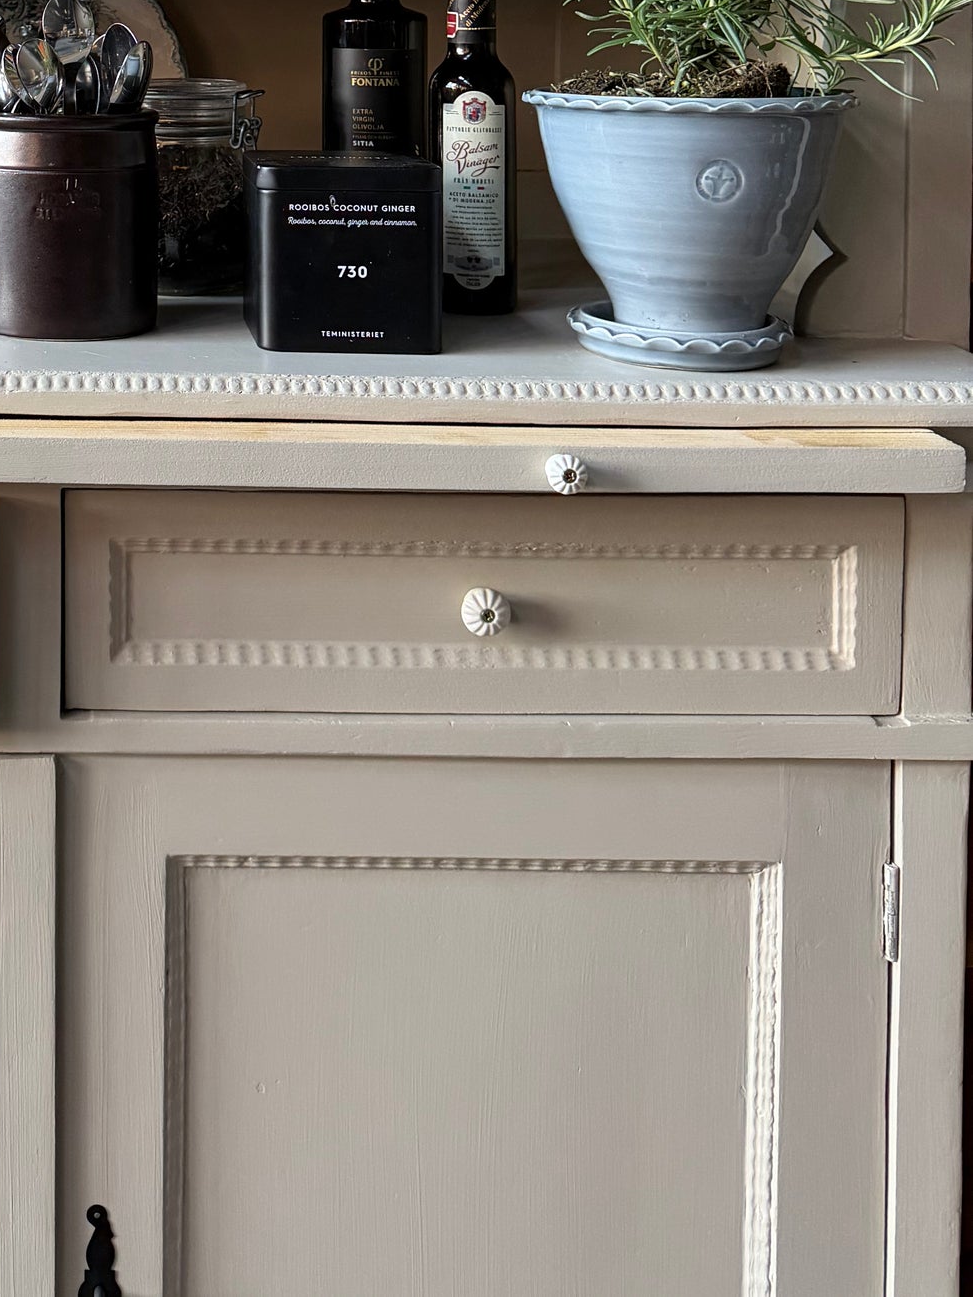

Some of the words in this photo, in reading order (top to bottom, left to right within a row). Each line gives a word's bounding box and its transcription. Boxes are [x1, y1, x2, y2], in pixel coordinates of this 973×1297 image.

[350, 77, 401, 87] FONTANA
[352, 139, 375, 148] SITIA
[446, 140, 499, 162] Balsam
[454, 154, 501, 178] Vinäger
[468, 192, 499, 200] BALSAMICO
[289, 203, 330, 212] ROOIBOS
[333, 204, 378, 213] COCONUT
[381, 205, 416, 213] GINGER
[287, 216, 317, 226] Rooibos,
[318, 217, 347, 226] coconut,
[347, 218, 369, 228] ginger
[369, 218, 383, 226] and
[337, 265, 368, 279] 730
[320, 330, 385, 338] TEMINISTERIET
